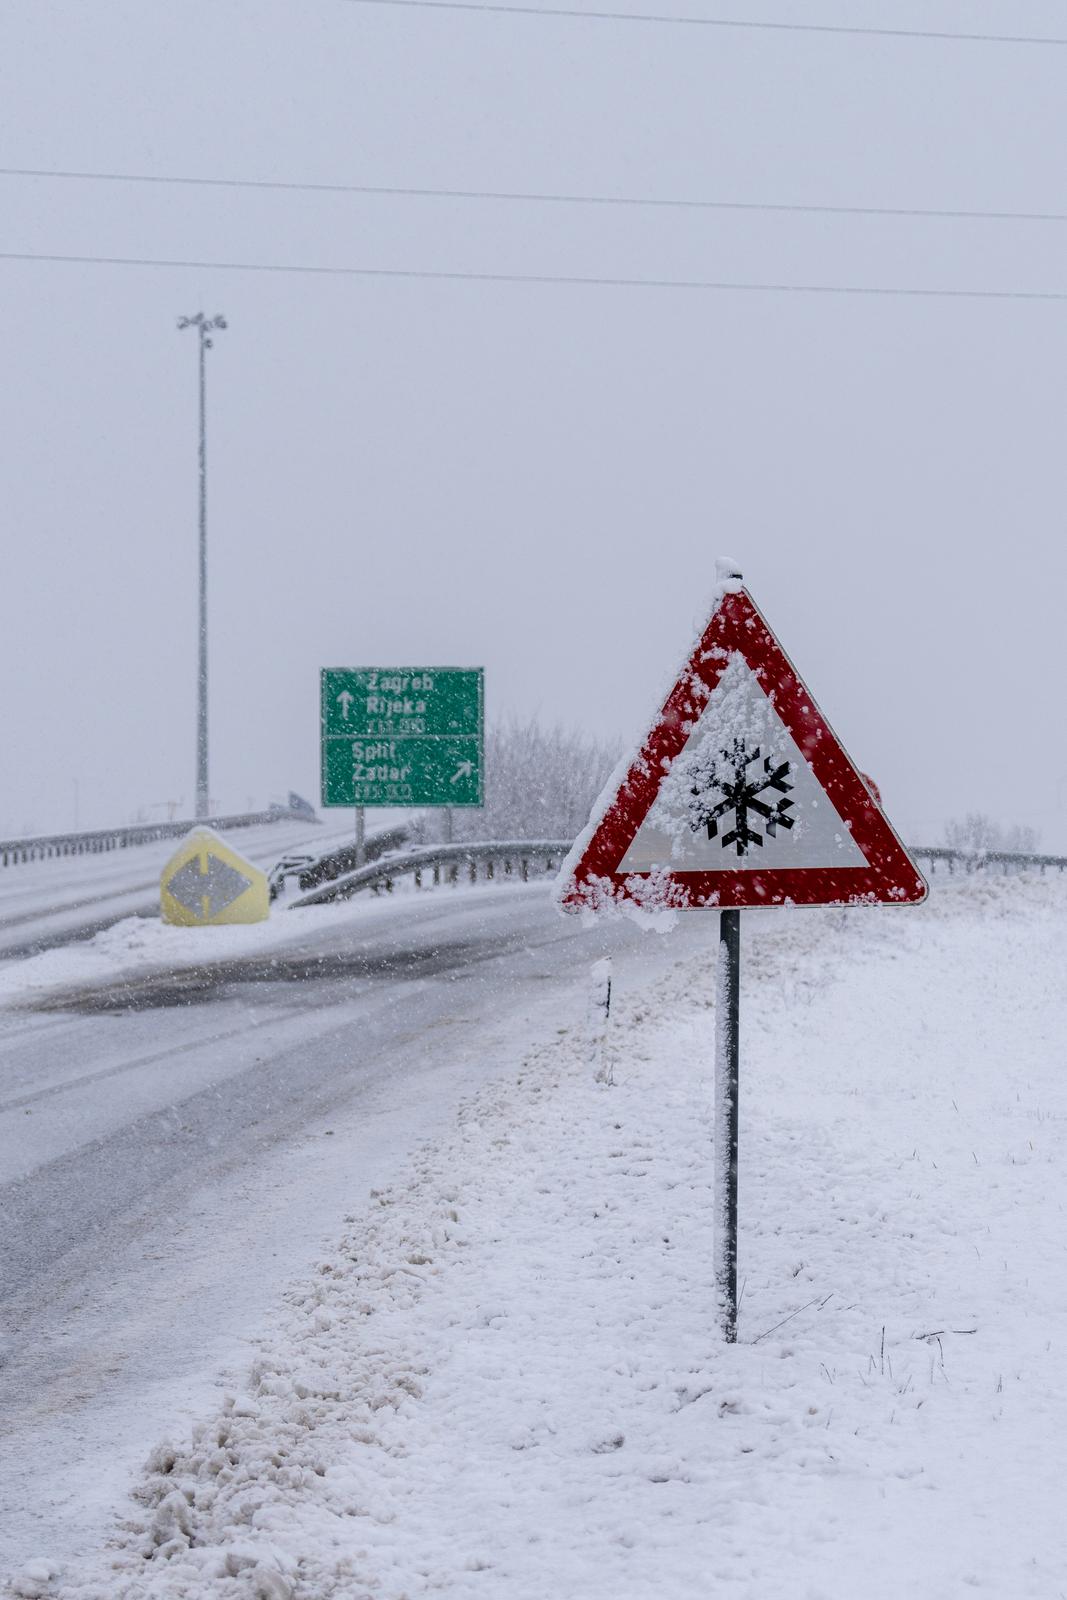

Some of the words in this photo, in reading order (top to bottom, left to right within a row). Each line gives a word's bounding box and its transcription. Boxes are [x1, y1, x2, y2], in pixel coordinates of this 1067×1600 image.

[367, 672, 434, 694] Zagreb
[366, 696, 427, 718] Rijeka
[352, 763, 412, 782] Zadar
